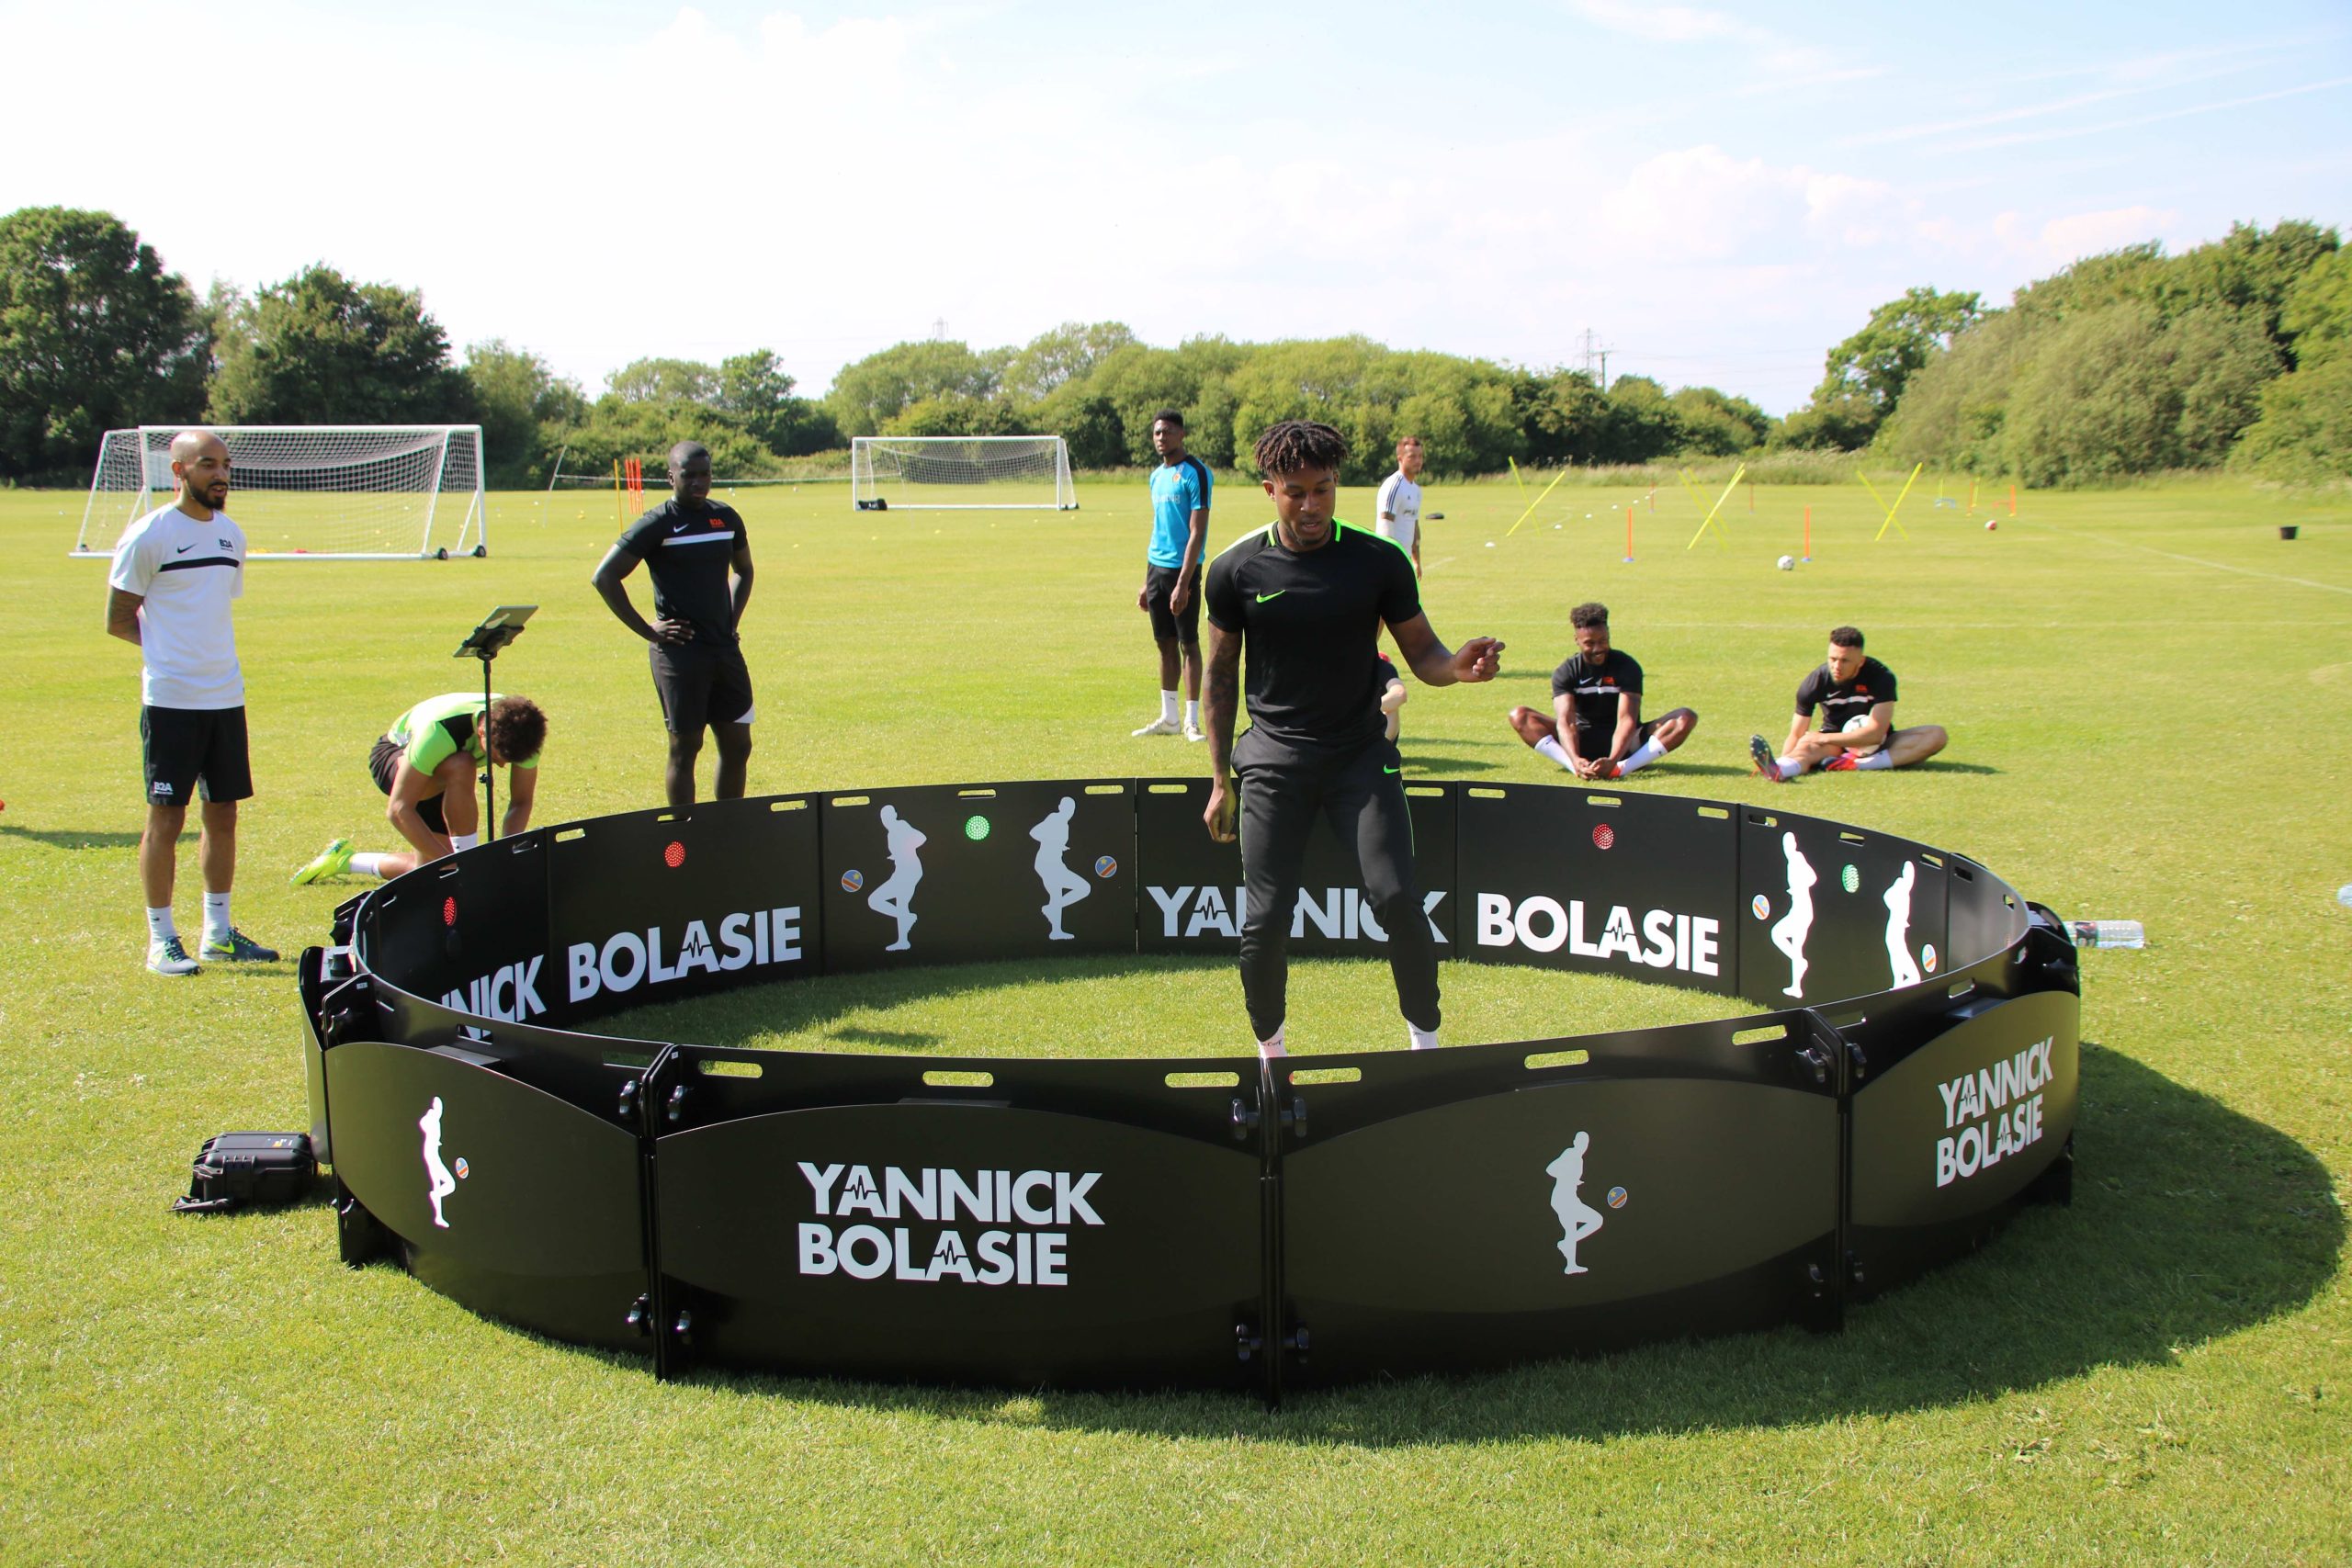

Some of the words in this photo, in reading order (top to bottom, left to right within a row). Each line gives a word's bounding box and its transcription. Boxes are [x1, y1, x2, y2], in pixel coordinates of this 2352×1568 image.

[153, 781, 174, 792] B2A
[568, 906, 801, 1003] BOLASIE
[1476, 892, 1719, 978] BOLASIE
[1938, 1035, 2053, 1129] YANNICK
[1936, 1093, 2043, 1189] BOLASIE
[797, 1161, 1105, 1225] YANNICK
[797, 1222, 1069, 1287] BOLASIE
